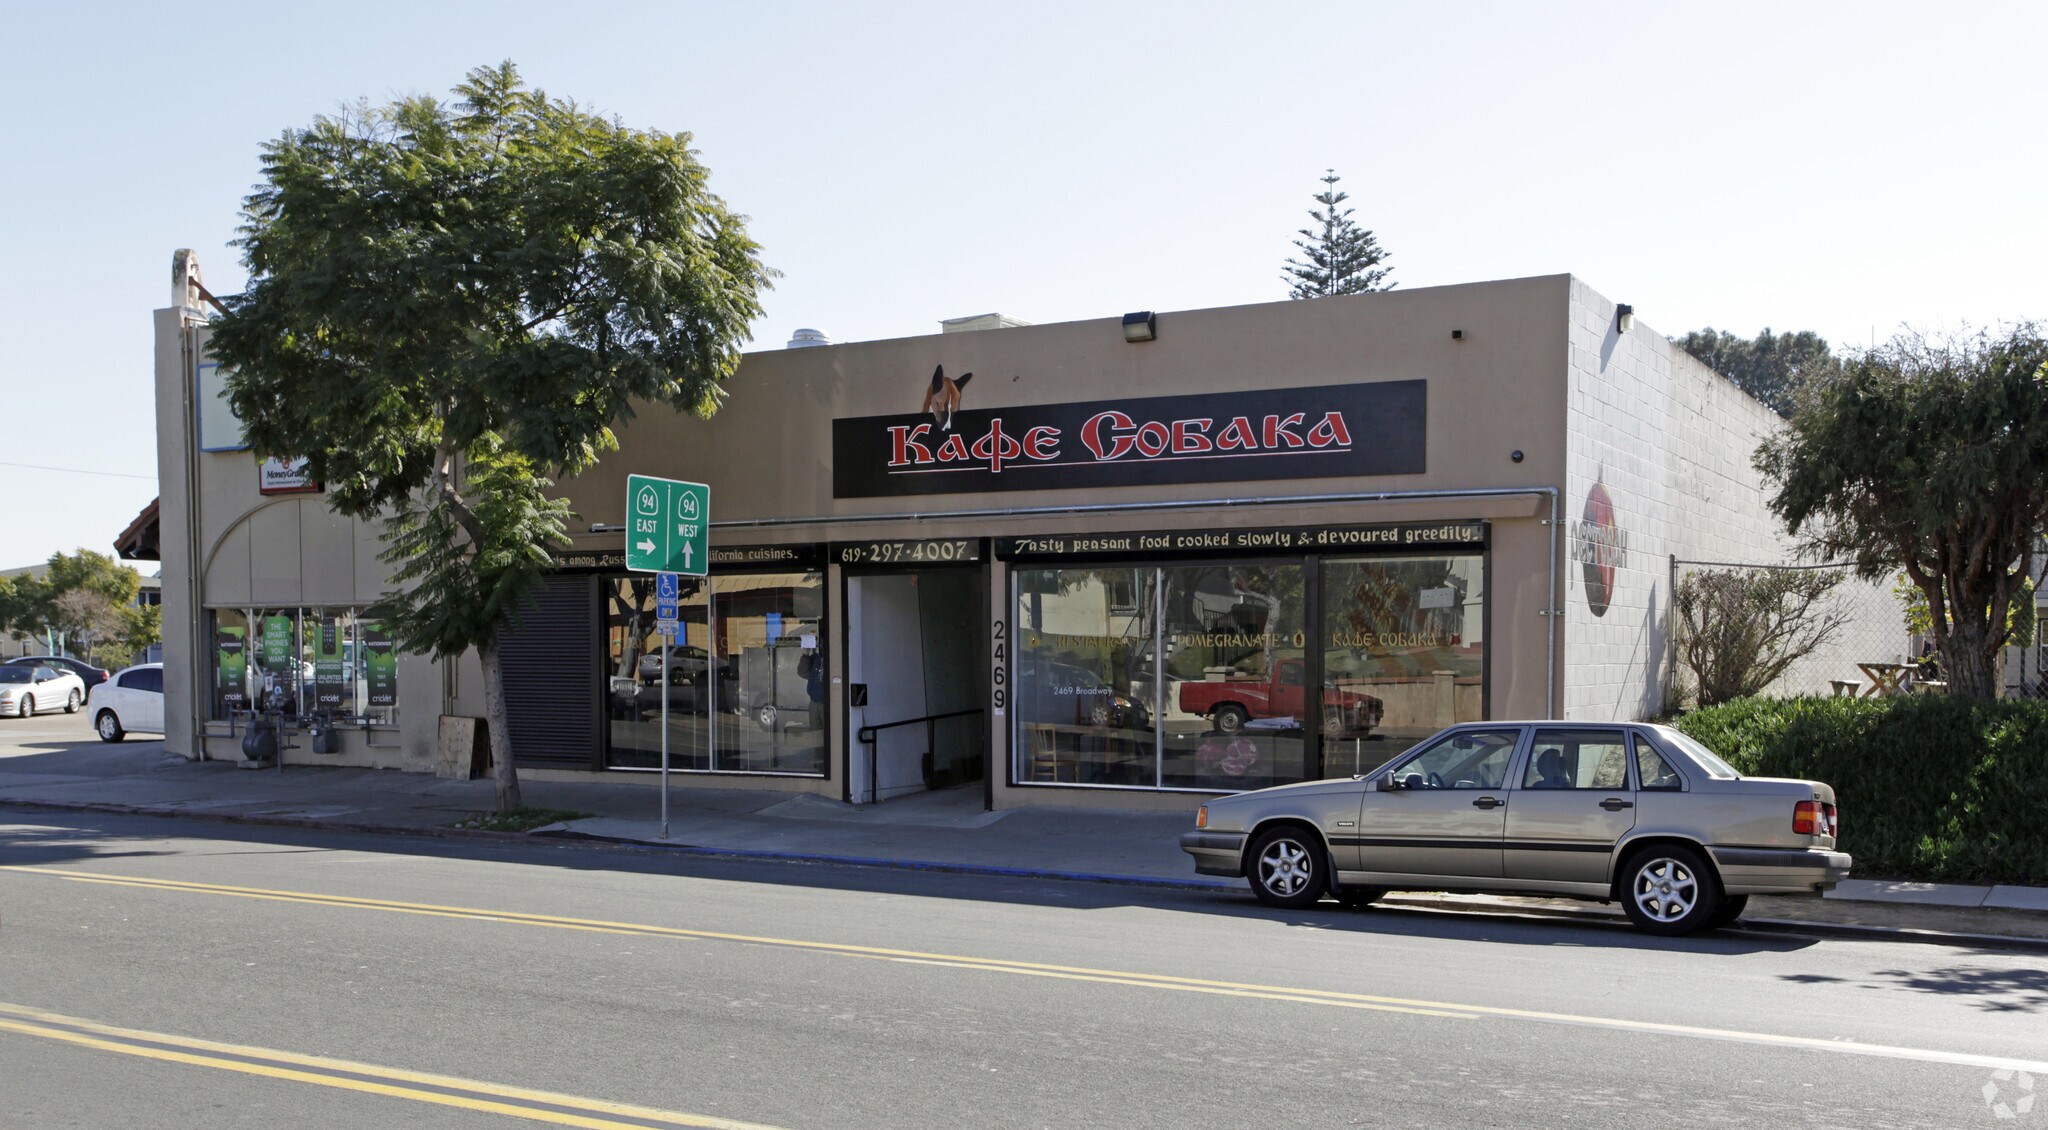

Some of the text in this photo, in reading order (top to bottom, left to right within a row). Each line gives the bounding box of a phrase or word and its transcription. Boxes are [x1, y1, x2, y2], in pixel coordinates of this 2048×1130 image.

[642, 494, 654, 509] 94
[683, 499, 695, 514] 94
[636, 518, 657, 533] EAST
[678, 523, 698, 538] WEST
[1014, 538, 1064, 554] Tasty
[1073, 537, 1131, 552] peasant
[1139, 534, 1170, 549] food
[1177, 532, 1229, 548] cooked
[1238, 531, 1291, 547] slowly
[1297, 532, 1314, 545] &
[1317, 528, 1398, 544] devoured
[569, 557, 596, 567] among
[600, 555, 627, 566] Russ
[708, 549, 744, 561] lifornia
[658, 597, 676, 606] PARKING
[662, 607, 673, 617] OY
[271, 623, 282, 631] THE
[264, 639, 289, 647] PHONES
[1177, 633, 1280, 648] POMEGRANATE
[270, 647, 283, 655] YOU
[268, 655, 286, 663] WANT
[994, 620, 1005, 709] 2469
[1053, 686, 1113, 697] 2469 Broadway
